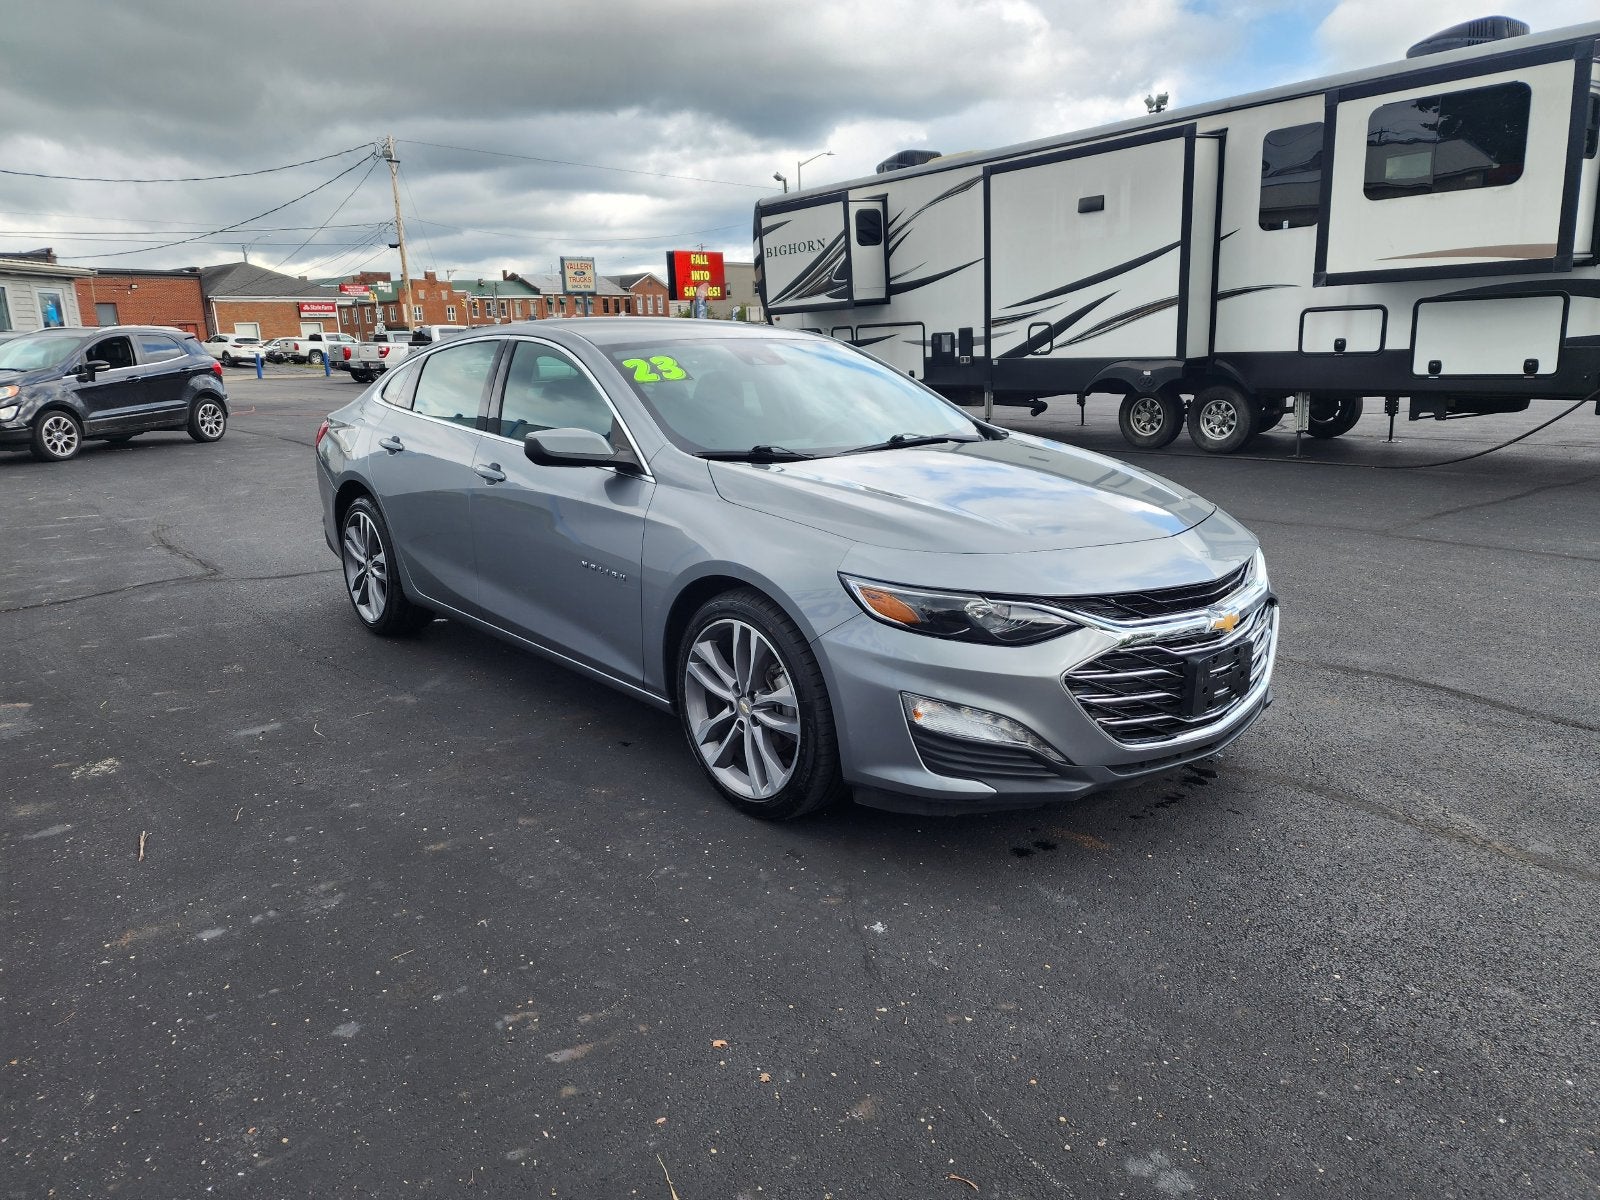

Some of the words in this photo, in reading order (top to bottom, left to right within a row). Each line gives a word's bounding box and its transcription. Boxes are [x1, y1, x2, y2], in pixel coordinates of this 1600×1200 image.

[766, 238, 826, 258] BIGHORN
[690, 253, 709, 265] FALL
[566, 262, 592, 270] VALLERY
[691, 270, 710, 281] INTO
[684, 286, 721, 297] SAVGS!
[622, 355, 687, 382] 23
